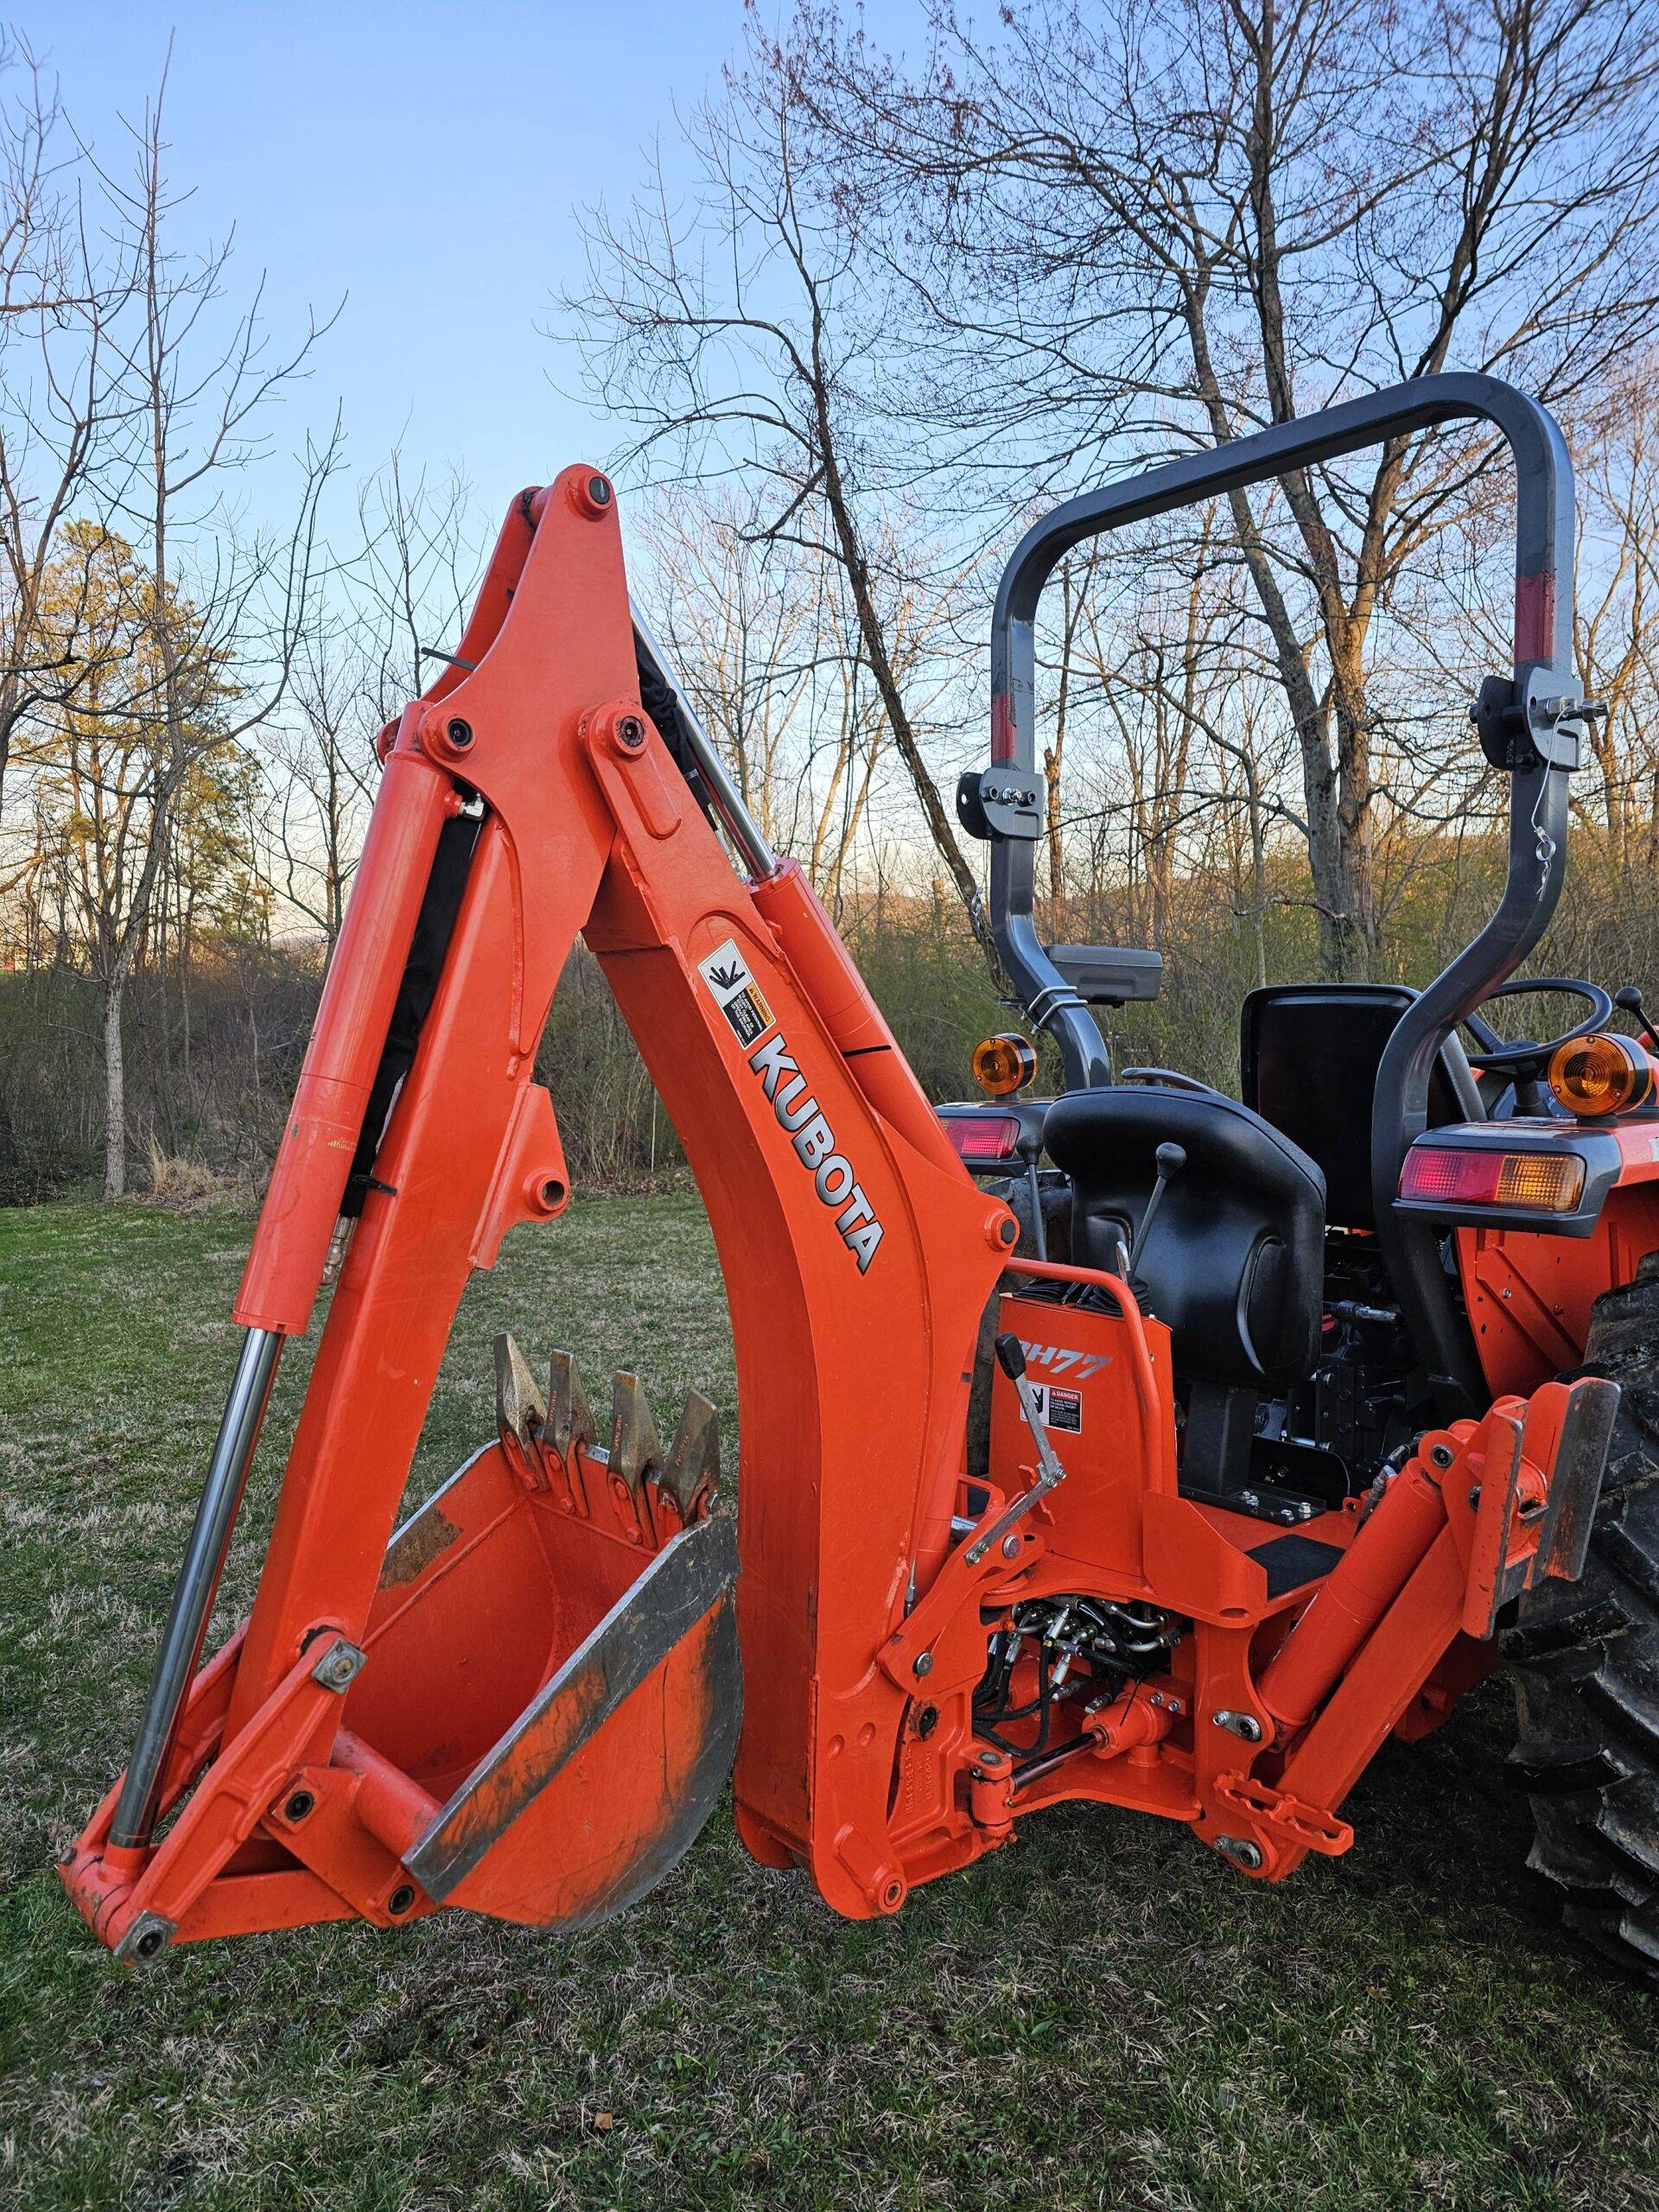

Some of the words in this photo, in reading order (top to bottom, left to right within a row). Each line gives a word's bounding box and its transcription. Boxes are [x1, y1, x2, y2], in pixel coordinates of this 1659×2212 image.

[752, 993, 770, 1022] WARNING
[748, 1032, 885, 1276] KUBOTA
[1056, 1390, 1077, 1400] DANGER
